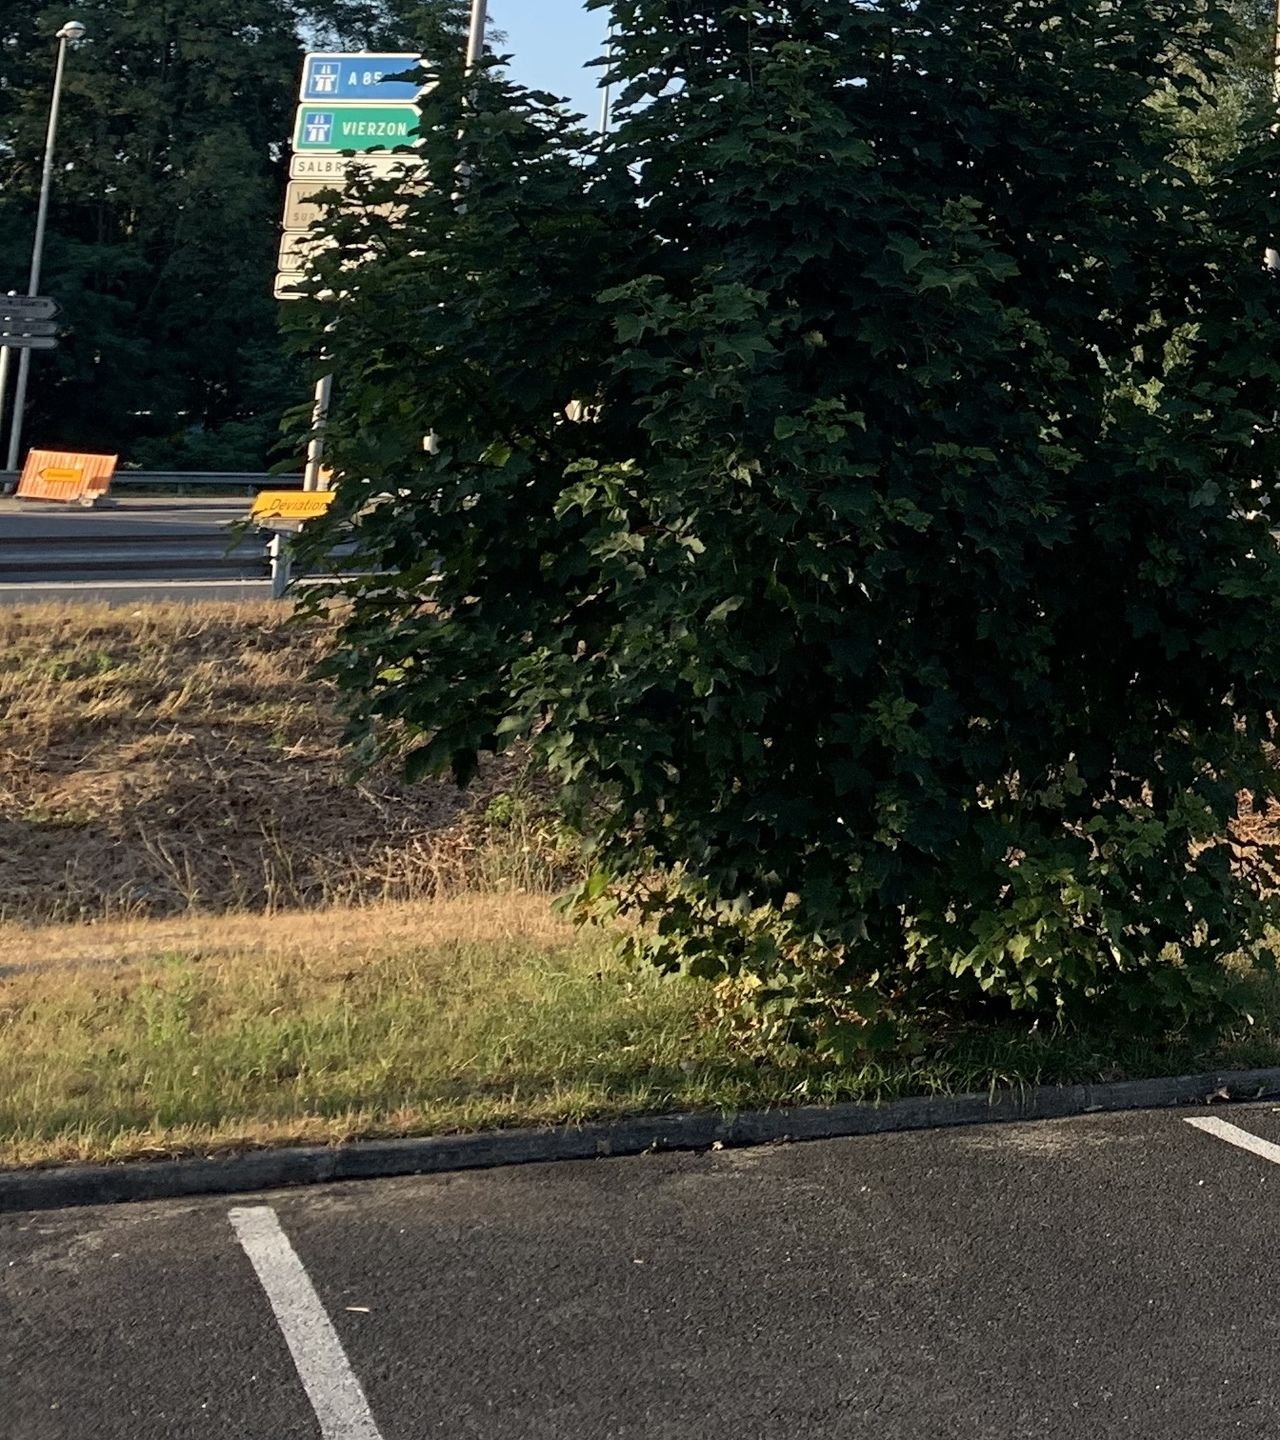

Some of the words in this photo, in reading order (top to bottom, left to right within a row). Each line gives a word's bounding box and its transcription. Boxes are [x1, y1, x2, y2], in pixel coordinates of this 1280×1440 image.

[348, 71, 358, 86] A
[342, 121, 407, 136] VIERZON
[298, 161, 342, 173] SALBR
